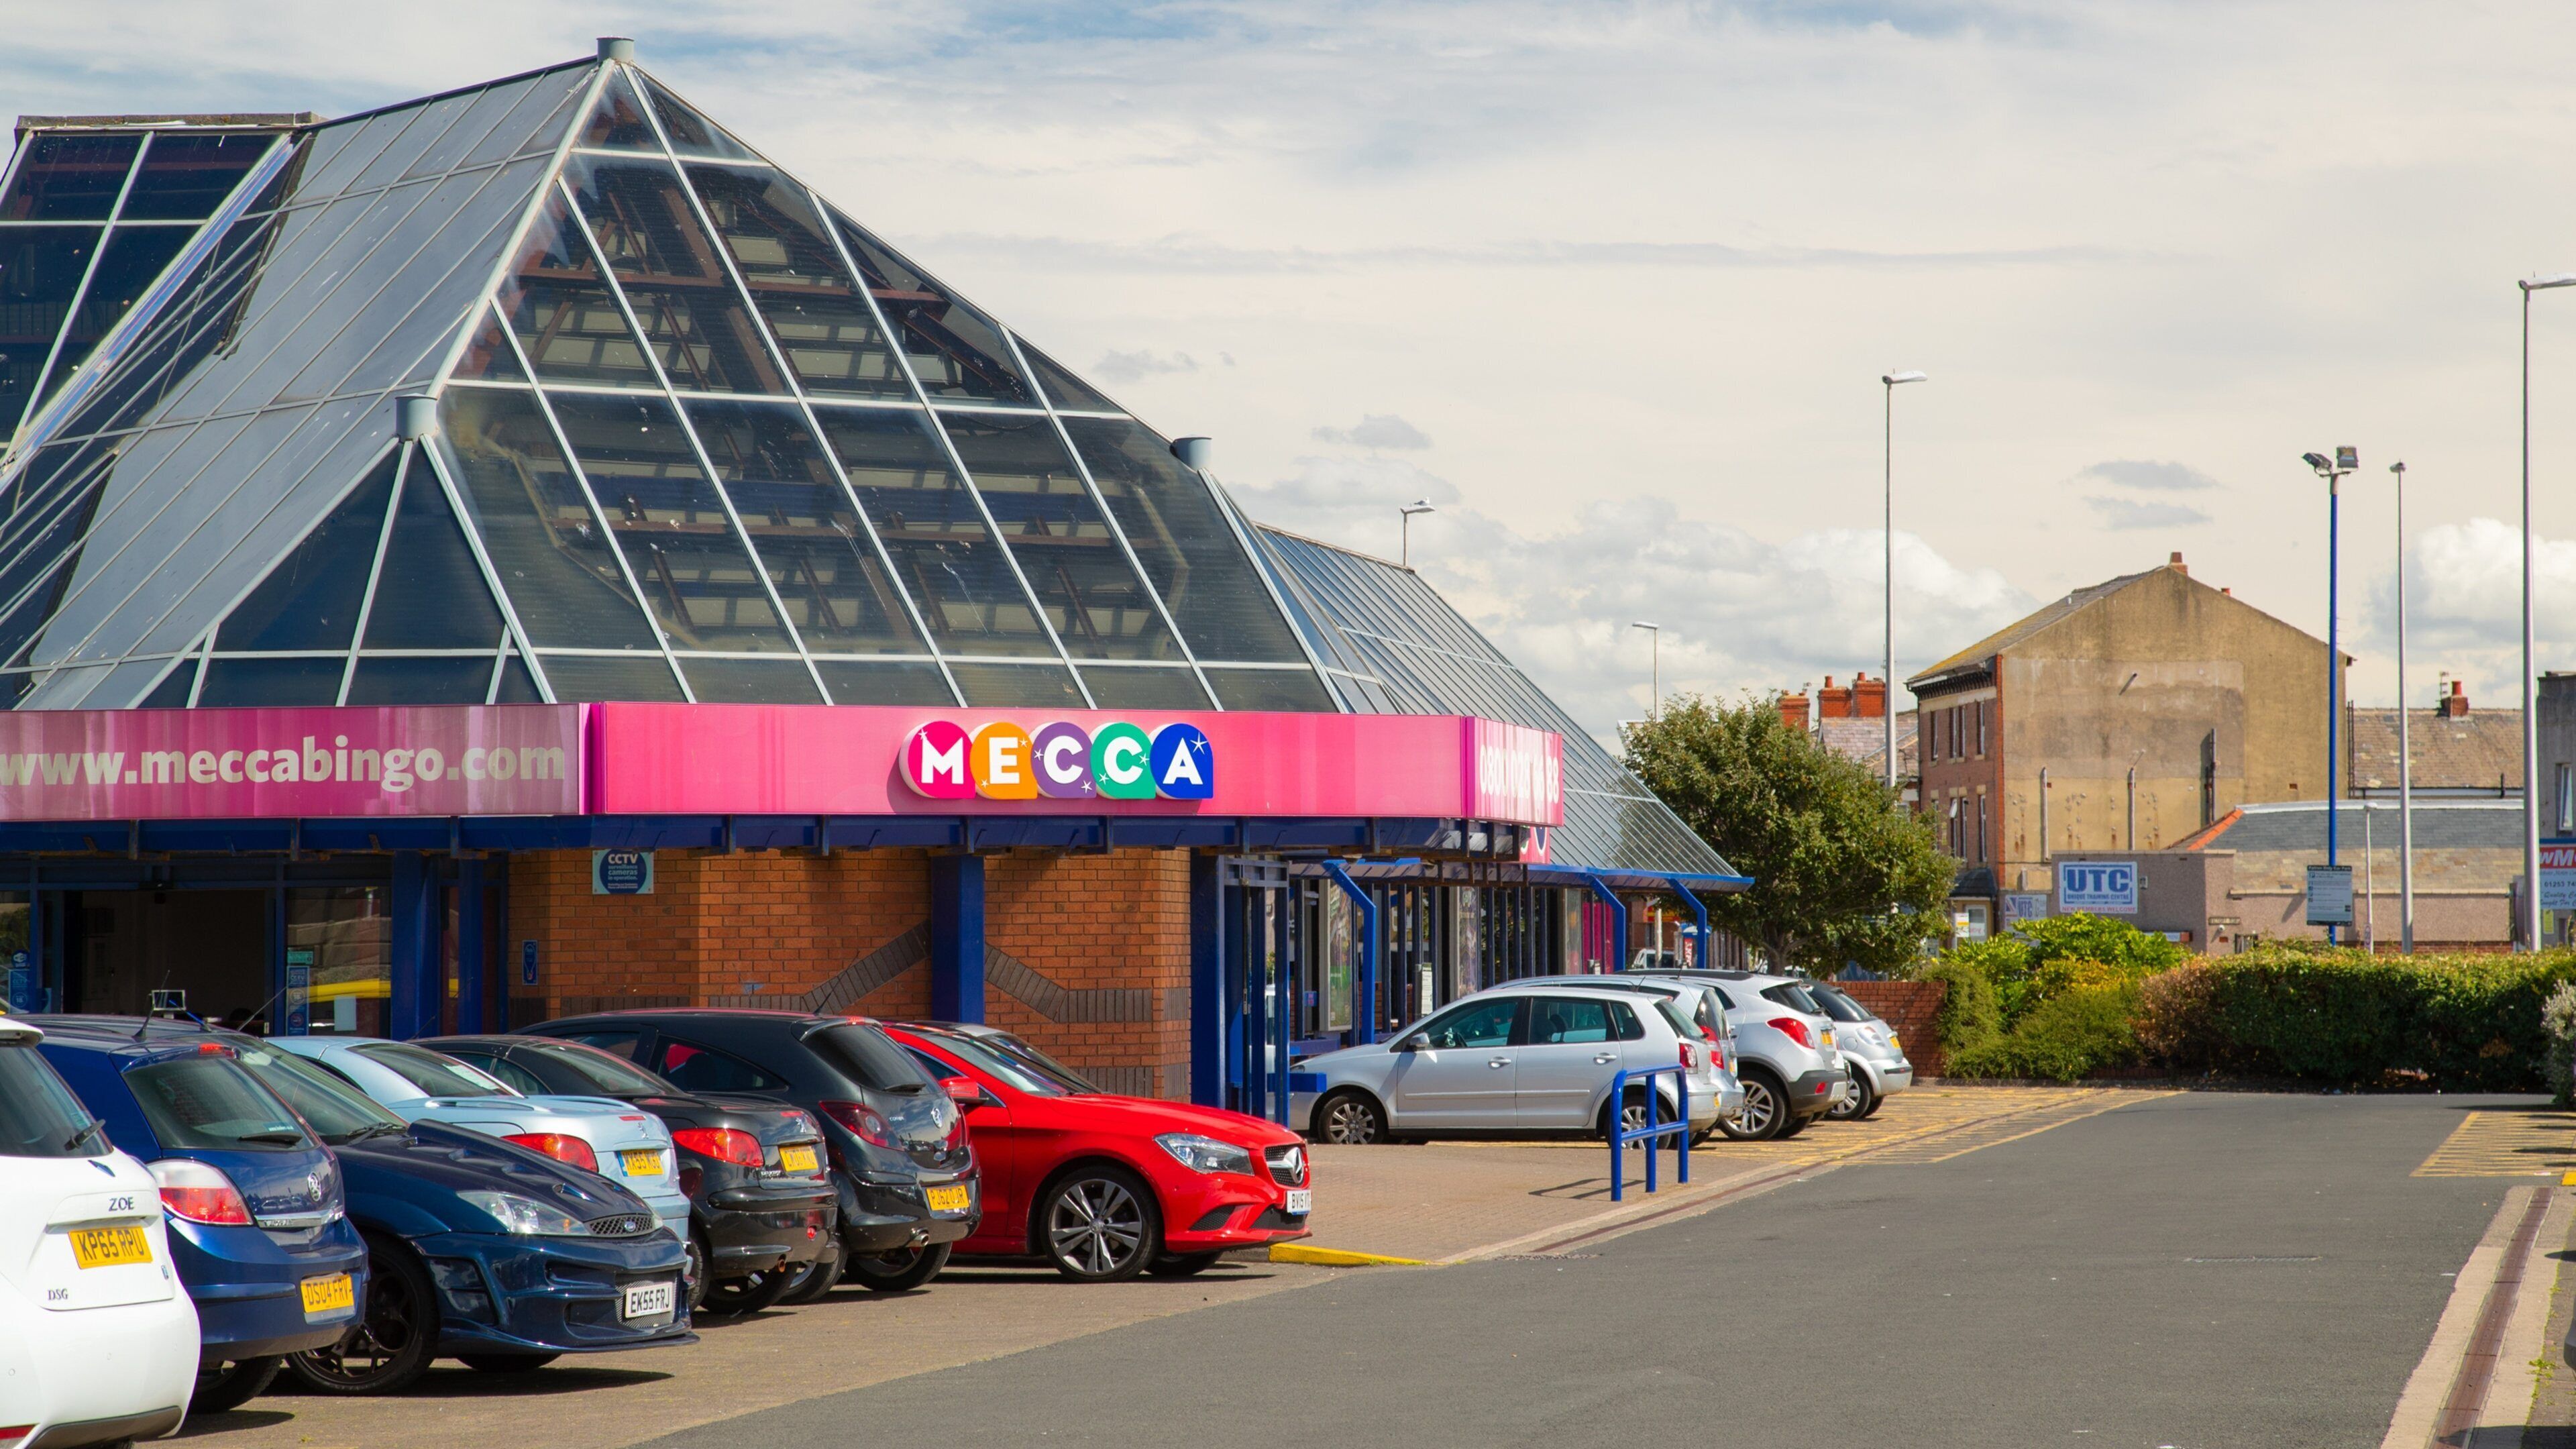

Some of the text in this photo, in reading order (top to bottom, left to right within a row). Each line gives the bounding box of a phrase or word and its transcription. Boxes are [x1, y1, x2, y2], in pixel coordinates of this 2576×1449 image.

[0, 735, 565, 792] www.meccabingo.com
[920, 735, 1204, 785] MECCA
[1480, 745, 1508, 797] 0800
[608, 854, 638, 864] CCTV
[2067, 869, 2129, 892] UTC
[2019, 900, 2033, 918] UTC
[108, 1197, 135, 1212] ZOE
[77, 1228, 144, 1261] KP65 RPU
[48, 1289, 68, 1301] DSG
[306, 1281, 331, 1306] DS04
[631, 1287, 669, 1313] EK55 FRJ
